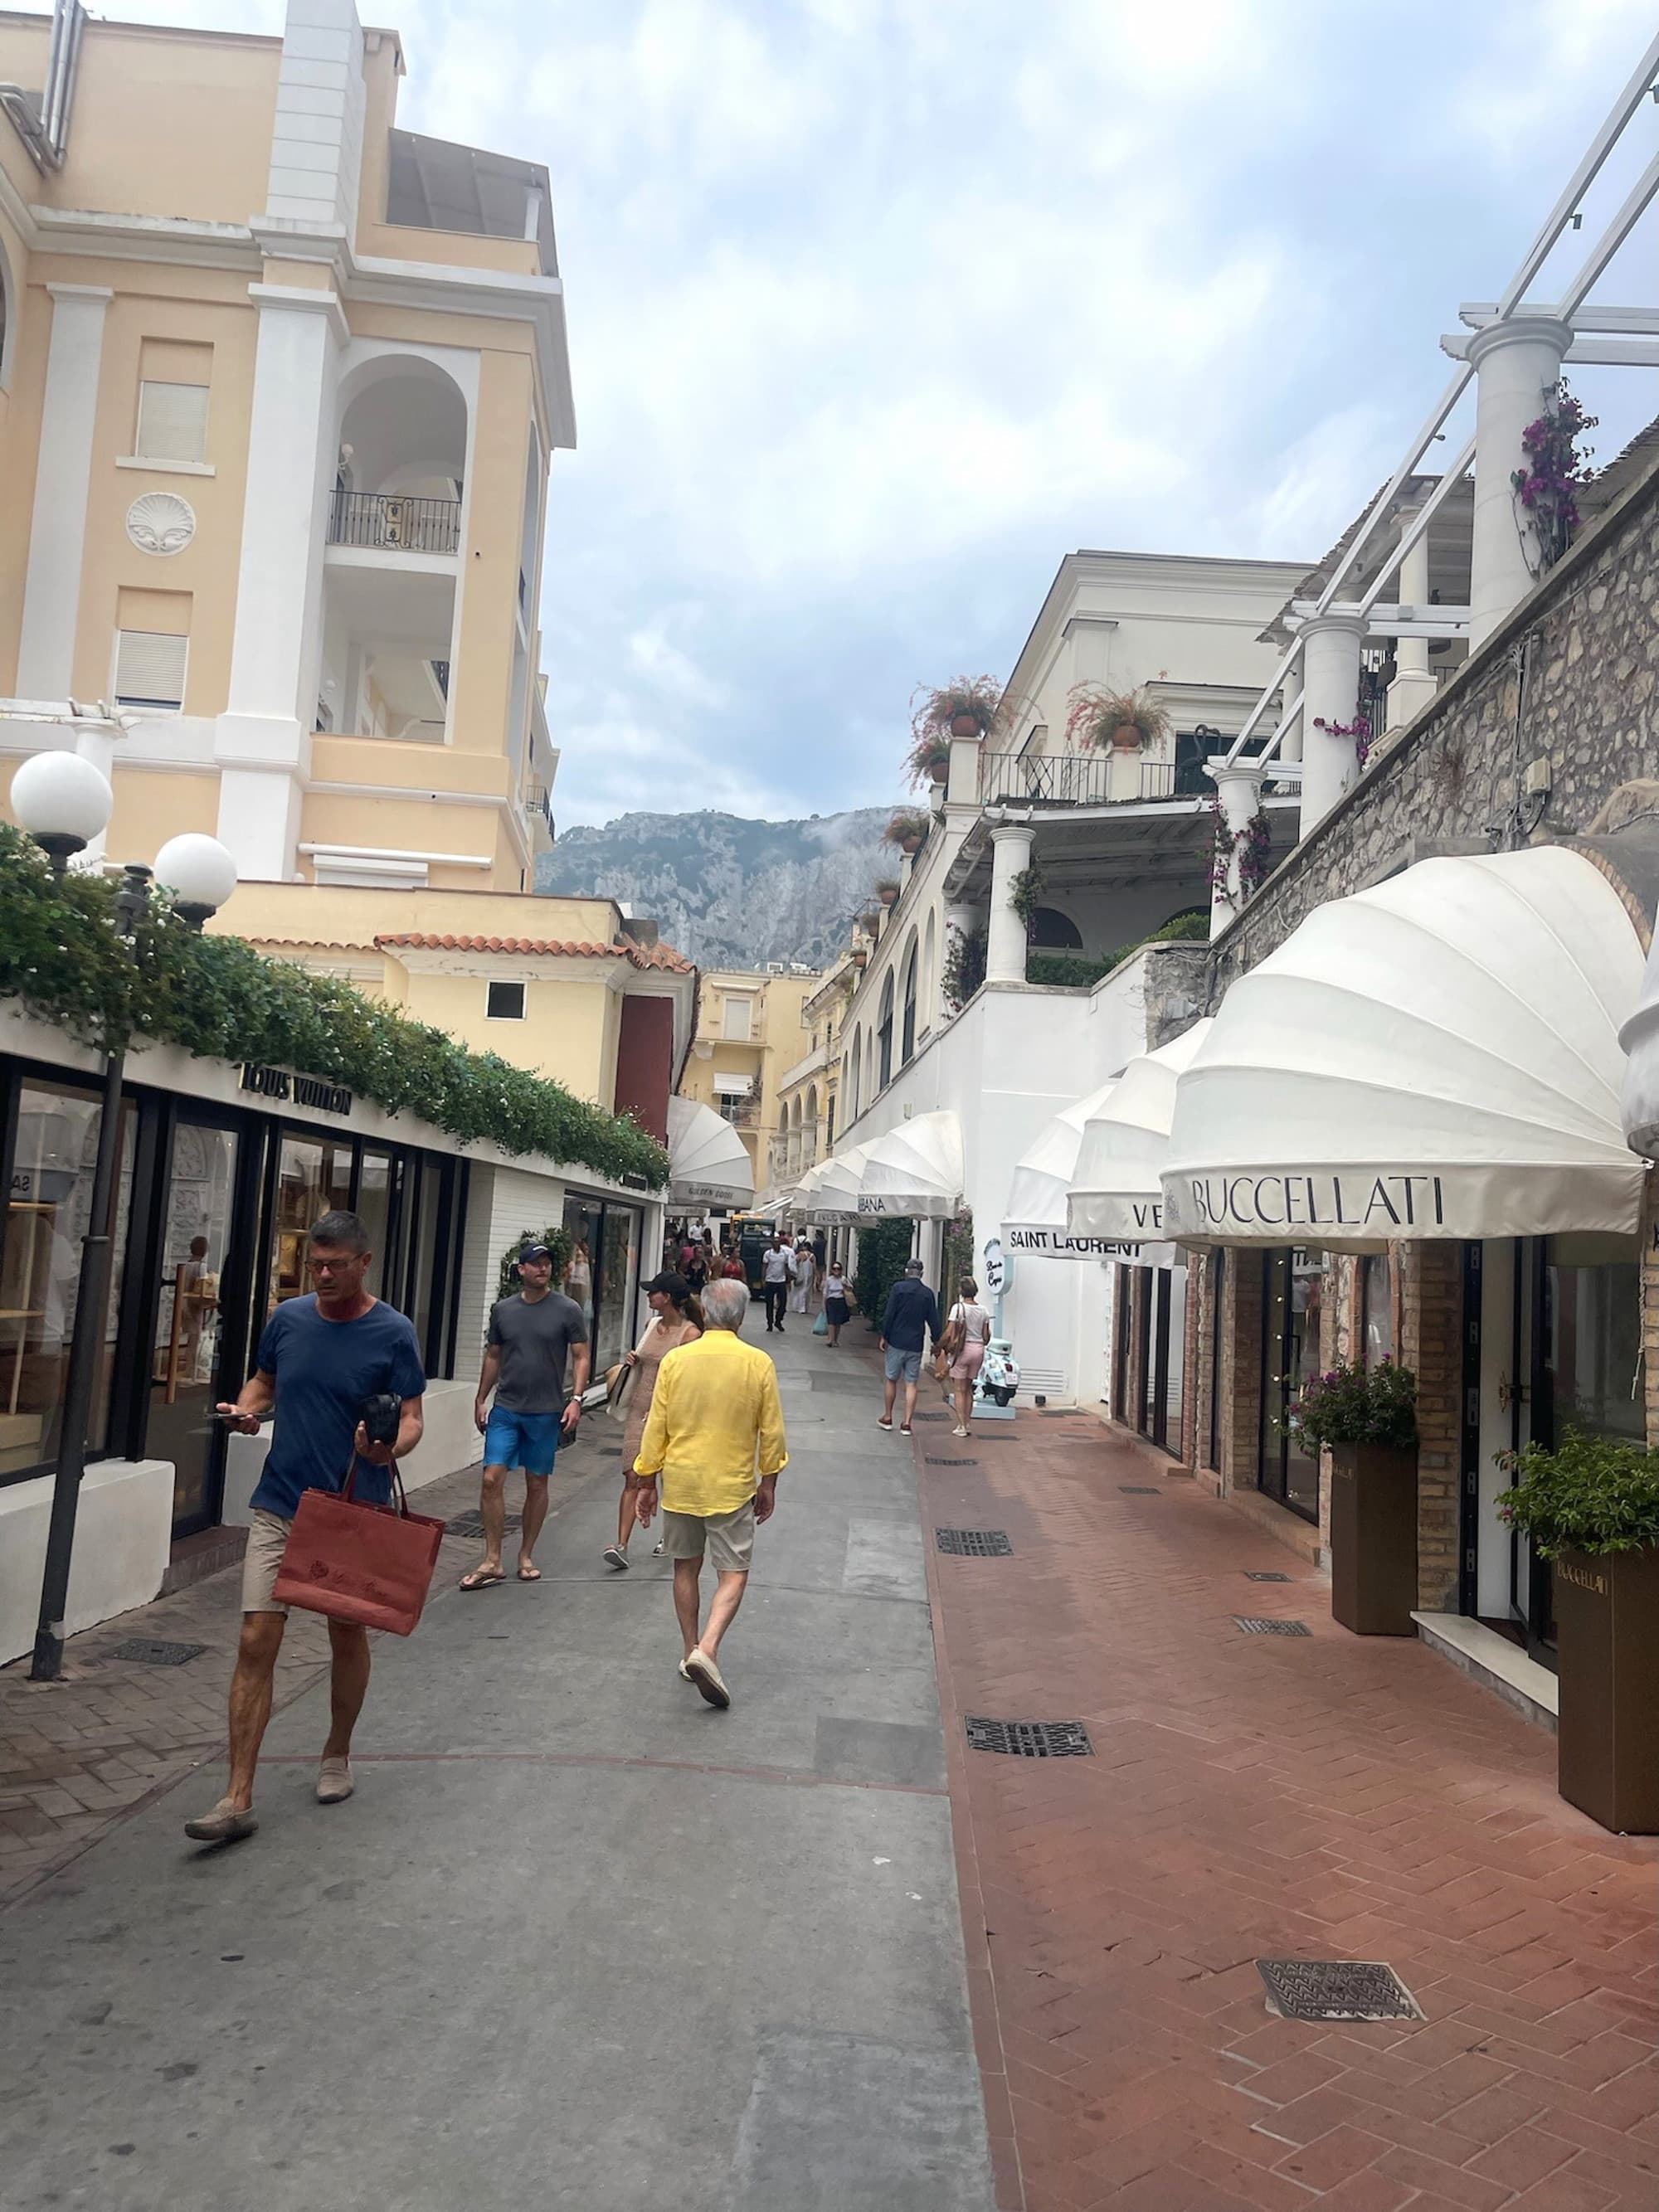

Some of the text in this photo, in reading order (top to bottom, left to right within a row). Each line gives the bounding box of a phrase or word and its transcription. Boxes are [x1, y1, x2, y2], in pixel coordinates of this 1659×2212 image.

[238, 1062, 353, 1116] LOUIS VUITTON
[1132, 1203, 1162, 1228] VE
[1191, 1175, 1444, 1225] BUCCELLATI
[1010, 1231, 1048, 1248] SAINT
